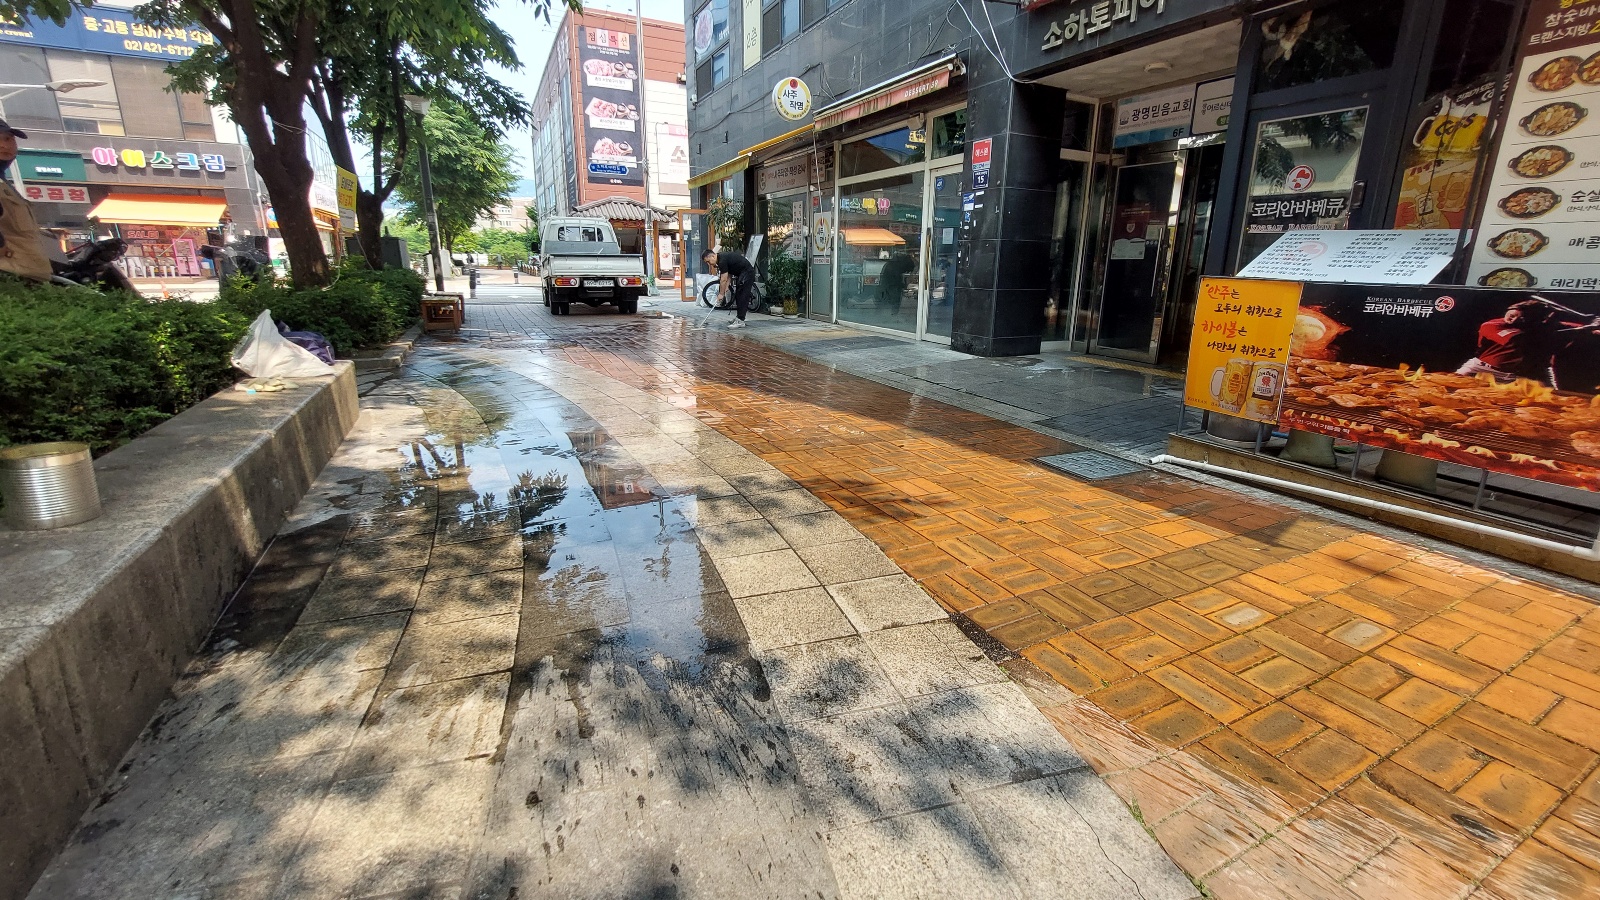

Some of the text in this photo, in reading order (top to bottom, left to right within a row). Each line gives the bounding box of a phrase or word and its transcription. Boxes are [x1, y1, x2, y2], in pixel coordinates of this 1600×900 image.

[588, 31, 628, 46] 점심특선
[1528, 23, 1591, 45] 트랜스지방
[783, 89, 798, 99] 사주
[904, 83, 930, 97] DESSERT
[789, 100, 804, 111] 작명
[1131, 98, 1193, 122] 광명믿음교회
[1172, 128, 1184, 137] 6F
[975, 147, 988, 157] 에스원
[92, 146, 226, 173] 아이스크림
[978, 175, 985, 184] 15
[1252, 198, 1344, 217] 코리안바베큐
[1568, 236, 1600, 249] 매콤
[1550, 277, 1600, 289] 데리떡
[1214, 303, 1282, 318] 모두의 취향으로
[1363, 303, 1434, 318] 코리안바베큐
[1202, 320, 1247, 338] 하이볼은
[1207, 342, 1237, 353] 나만의
